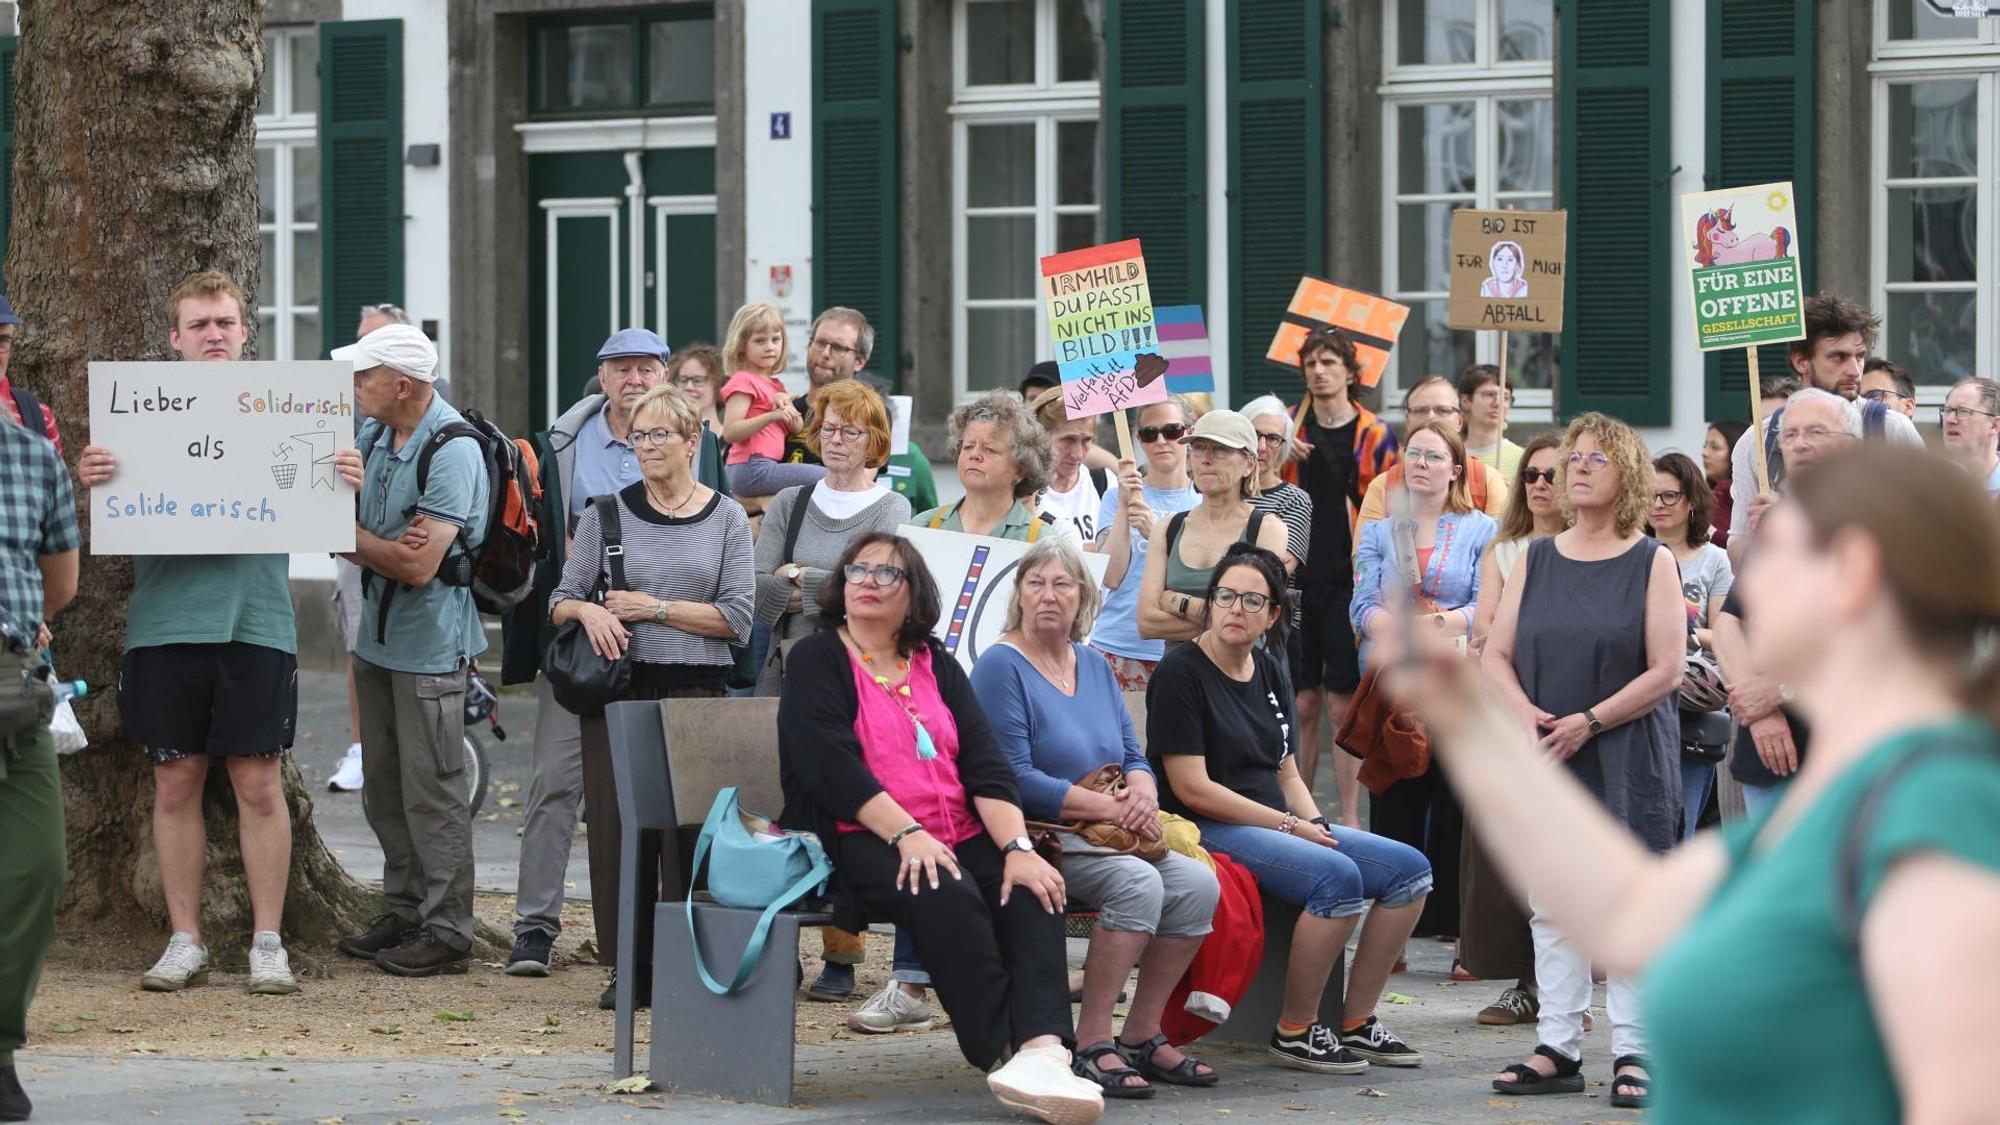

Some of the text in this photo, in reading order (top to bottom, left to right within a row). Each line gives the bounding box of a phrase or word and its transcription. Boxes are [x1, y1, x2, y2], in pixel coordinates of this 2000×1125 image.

[774, 115, 785, 137] 4
[1512, 218, 1537, 234] IST
[1050, 262, 1140, 297] IRMHILD
[1532, 259, 1561, 274] MICH
[1697, 266, 1794, 293] FÜR EINE
[1054, 284, 1145, 318] DU PASST
[1482, 303, 1546, 324] ABFALL
[1700, 288, 1796, 318] OFFENE
[1057, 305, 1152, 339] NICHT INS
[1702, 312, 1798, 334] GESELLSCHAFT
[1066, 363, 1106, 411] Vielfalt
[1100, 357, 1125, 395] statt
[110, 380, 352, 417] Lieber Solidarisch
[1108, 376, 1136, 411] AfD
[187, 434, 225, 460] als
[106, 492, 276, 522] Solide arisch
